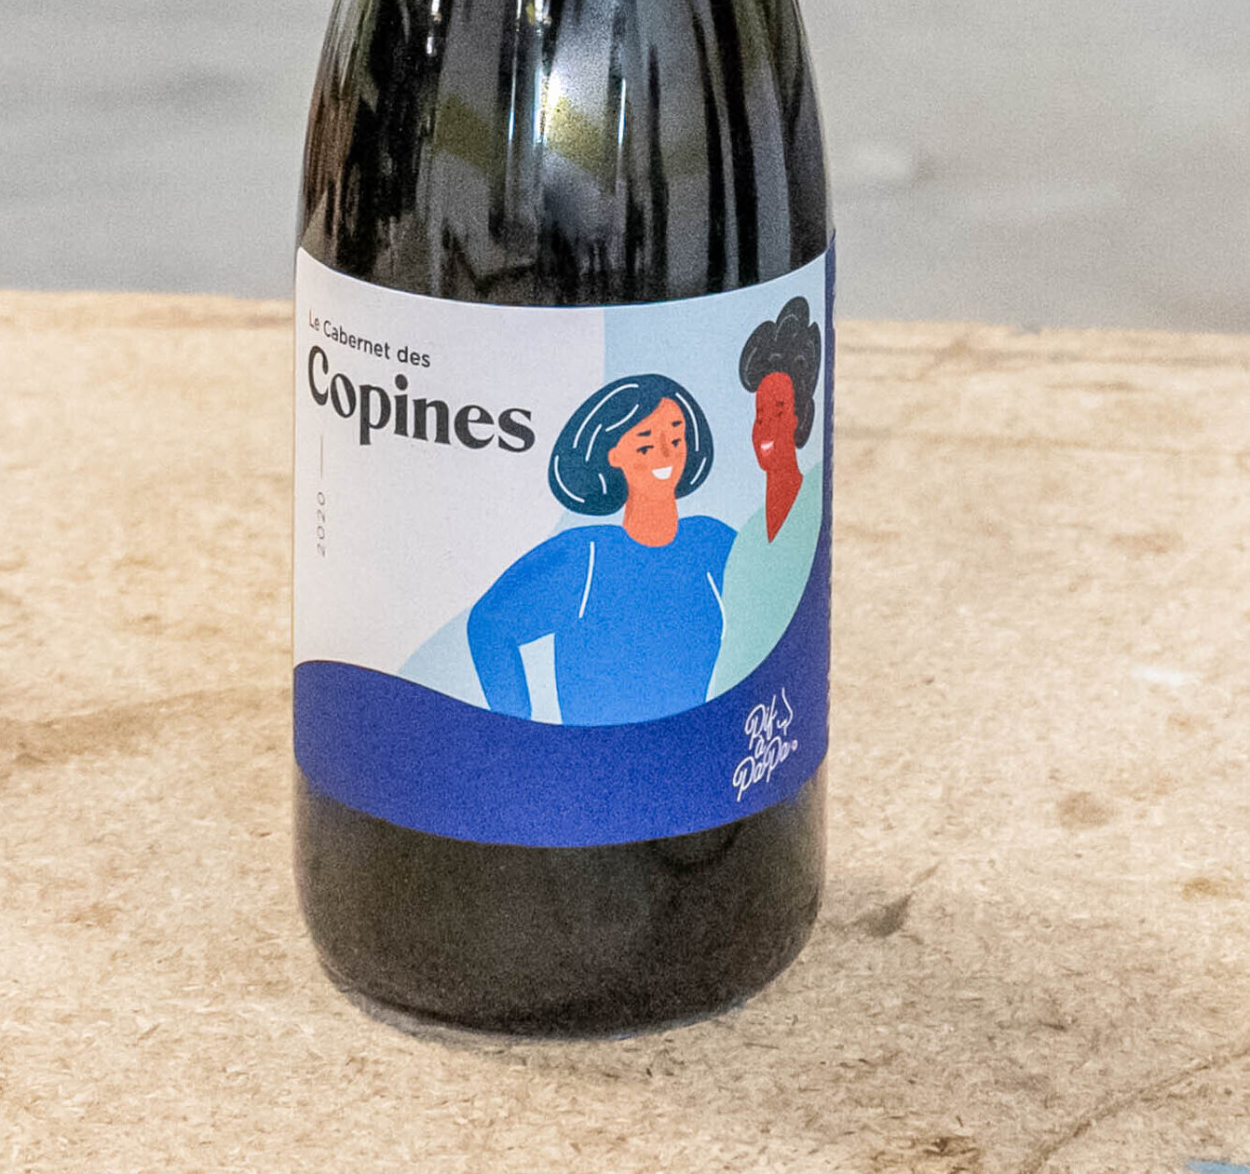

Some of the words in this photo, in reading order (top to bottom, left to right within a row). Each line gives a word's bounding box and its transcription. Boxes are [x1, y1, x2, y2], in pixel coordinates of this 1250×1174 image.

[309, 308, 320, 331] Le
[323, 320, 391, 359] Cabernet
[397, 346, 431, 368] des
[308, 345, 536, 453] Copines
[316, 491, 326, 559] 2020
